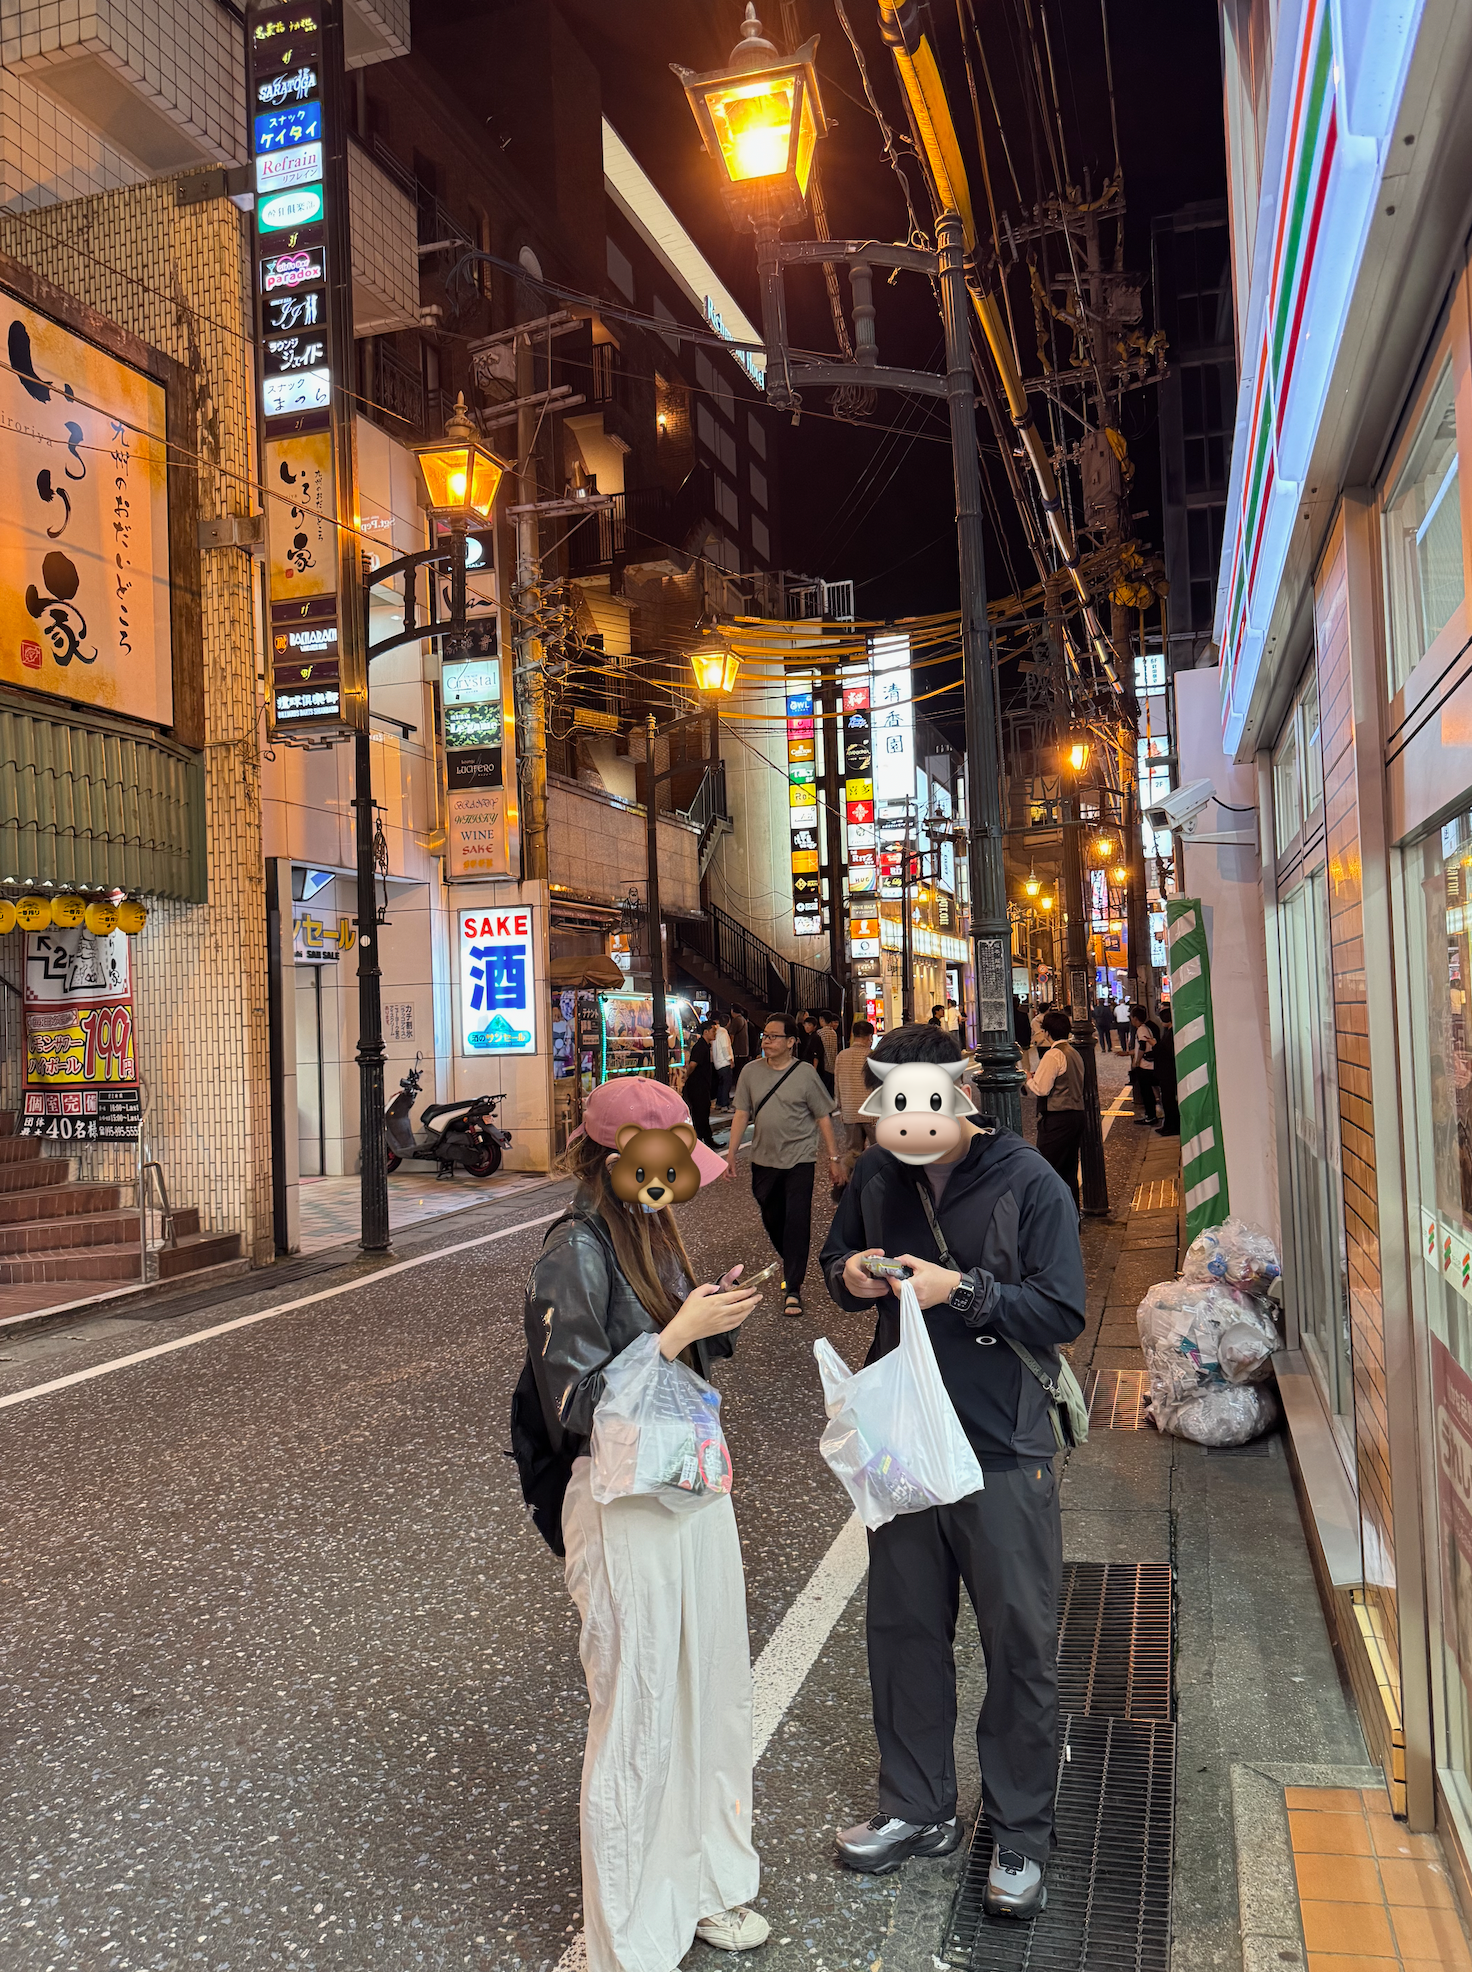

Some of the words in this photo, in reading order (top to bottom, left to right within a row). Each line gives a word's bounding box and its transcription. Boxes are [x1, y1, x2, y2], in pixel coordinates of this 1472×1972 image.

[258, 73, 317, 105] SARATOGA
[269, 110, 306, 128] スナック
[260, 121, 317, 149] ケイタイ
[262, 152, 317, 176] Refrain
[282, 169, 318, 184] リフレイン
[267, 268, 320, 290] paradox
[268, 337, 299, 353] ラウンジ
[280, 342, 323, 371] ジェイド
[267, 378, 305, 394] スナック
[1, 410, 53, 447] iroriya
[882, 682, 904, 754] 清香園
[454, 797, 499, 810] BRANDY
[454, 812, 499, 825] WHISKY
[460, 829, 495, 841] WINE
[462, 844, 494, 856] SAKE
[464, 914, 528, 939] SAKE
[322, 950, 340, 960] SALE
[469, 944, 526, 1011] 酒
[28, 1056, 82, 1076] ハイボール
[1441, 1418, 1472, 1500] うれし
